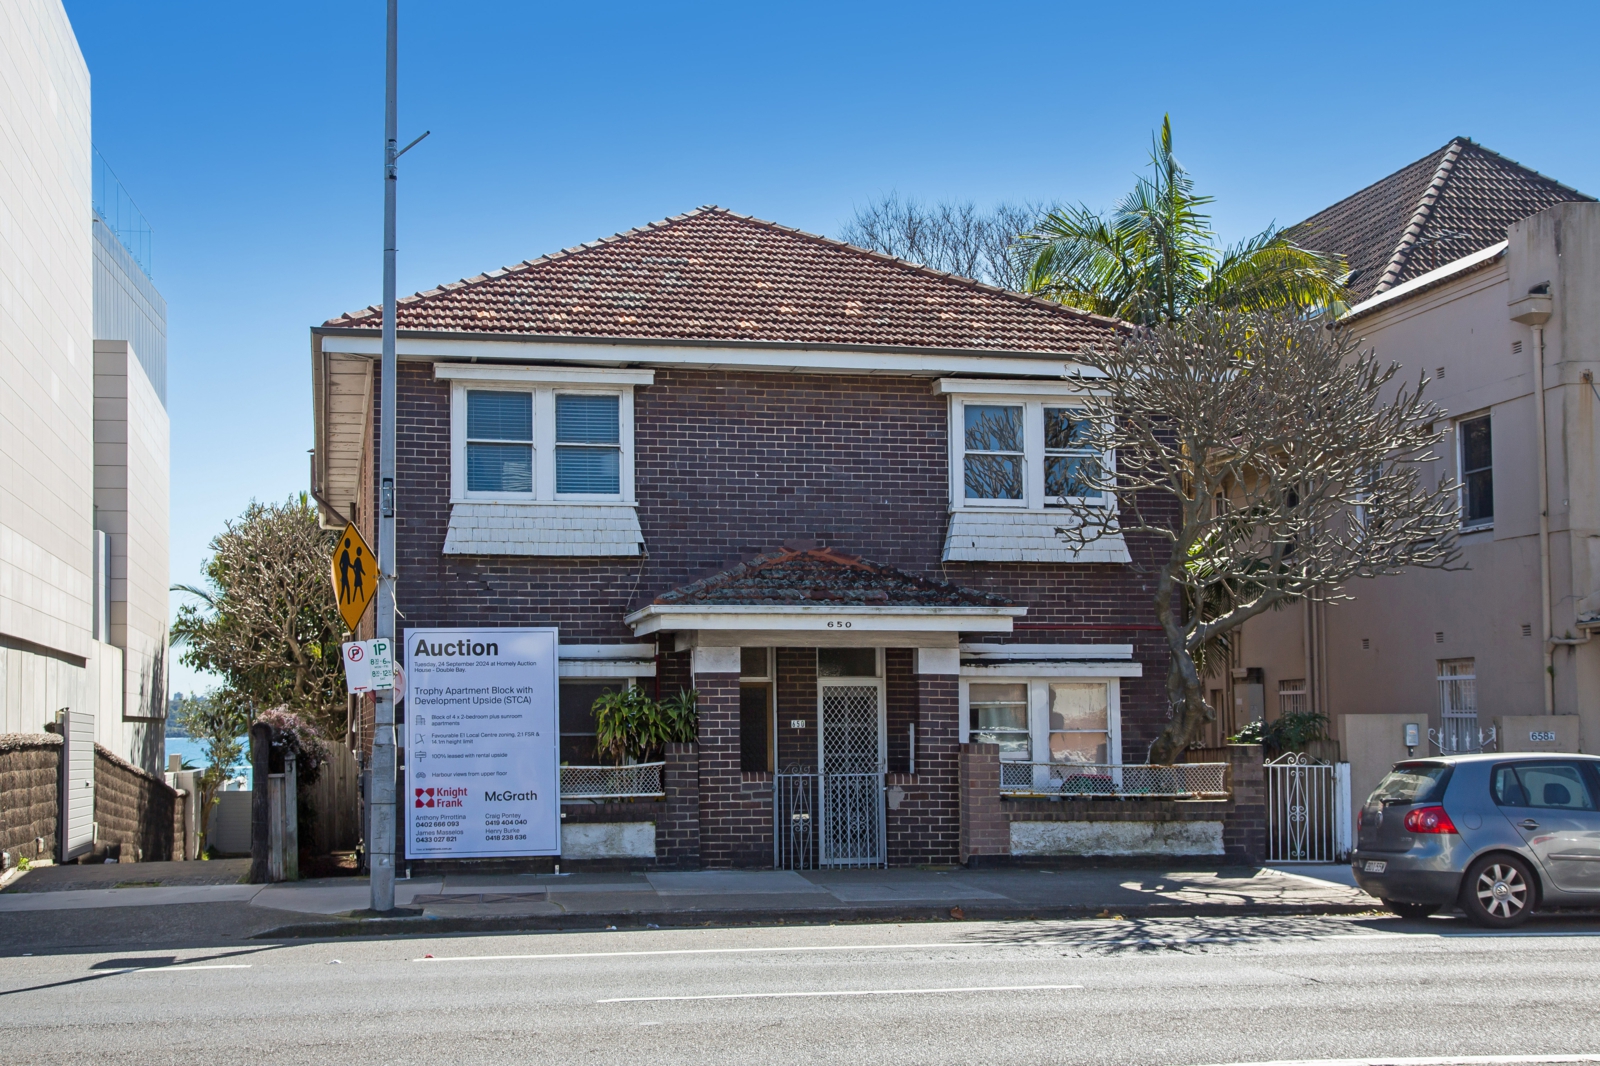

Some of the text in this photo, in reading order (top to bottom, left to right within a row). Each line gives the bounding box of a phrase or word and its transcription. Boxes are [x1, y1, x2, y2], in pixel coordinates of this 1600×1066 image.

[373, 644, 386, 656] 1P
[414, 638, 498, 656] Auction
[414, 687, 443, 696] Trophy
[445, 686, 489, 696] Apartment
[492, 686, 514, 694] Block
[414, 696, 532, 706] Development Upside (STCA)
[437, 787, 468, 798] Knight
[485, 790, 537, 802] McGrath
[437, 799, 463, 808] Frank
